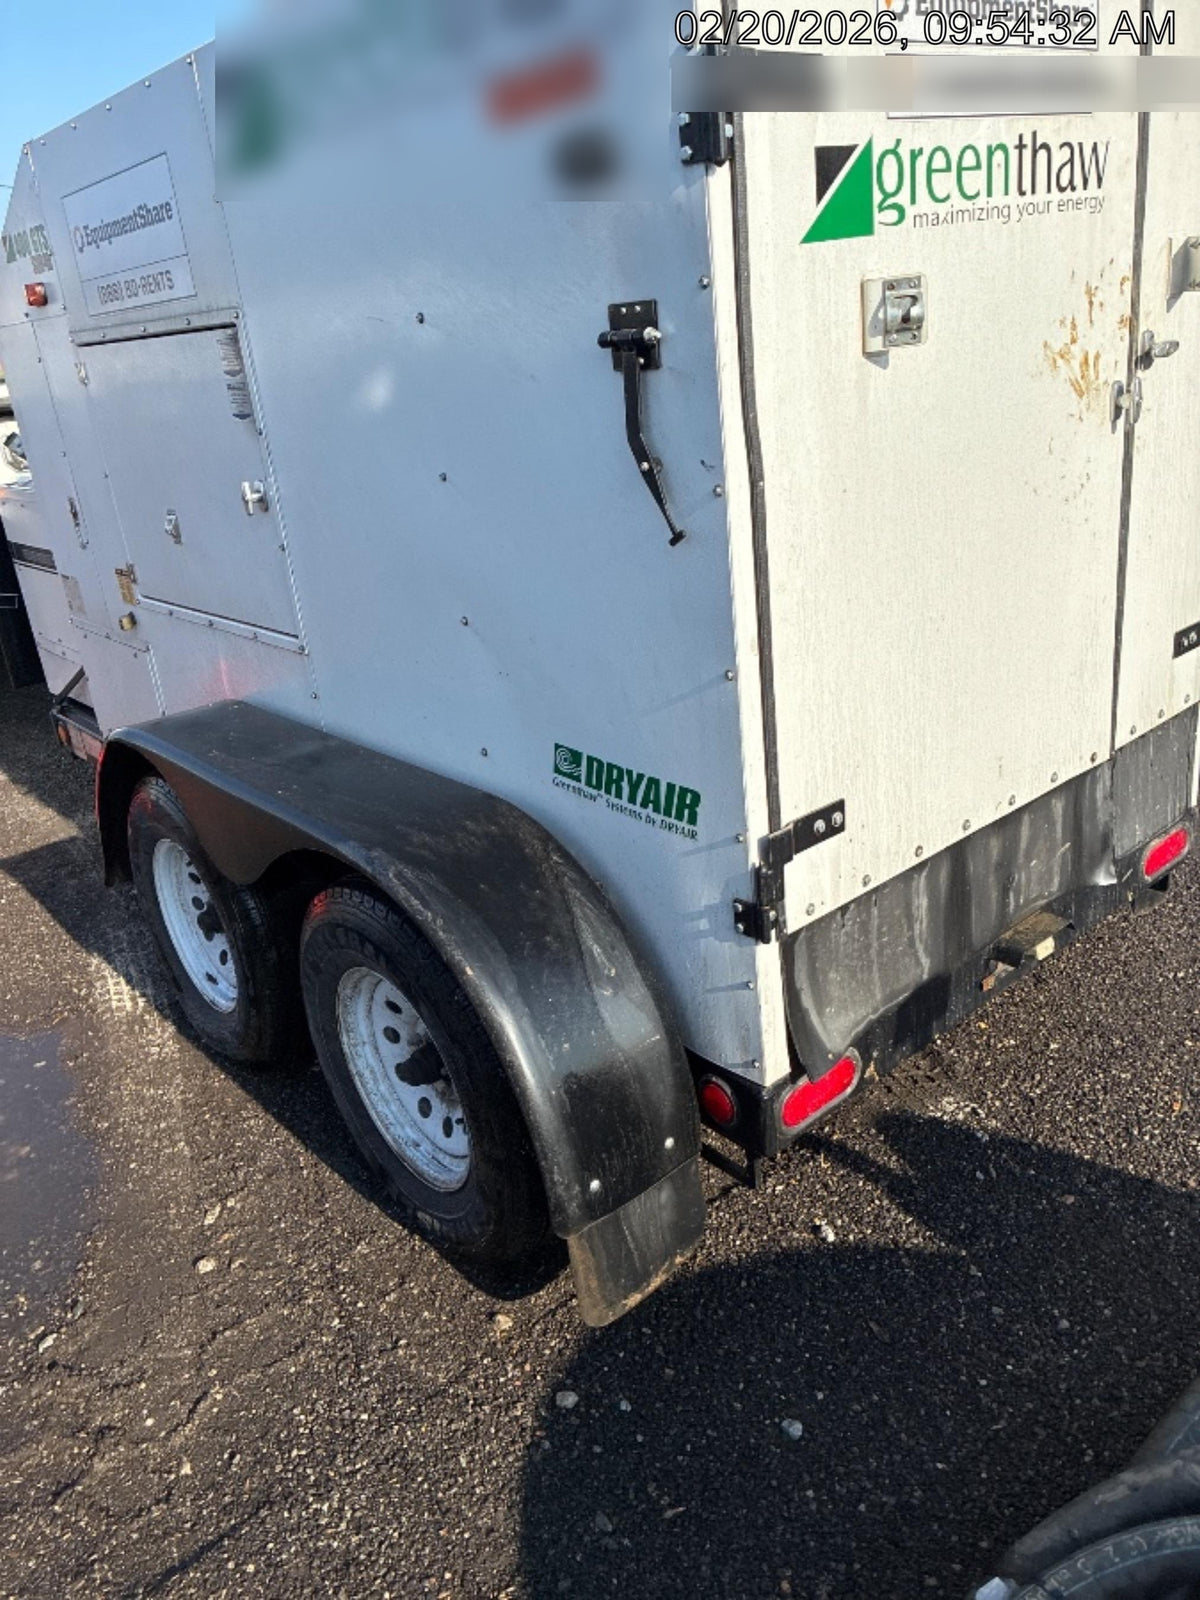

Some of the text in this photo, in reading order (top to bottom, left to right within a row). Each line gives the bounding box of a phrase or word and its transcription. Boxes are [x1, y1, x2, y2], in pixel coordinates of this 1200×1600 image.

[876, 129, 1110, 226] greenthaw
[82, 201, 174, 250] EquipmentShare
[913, 195, 1105, 228] maximizing your energy
[585, 754, 701, 826] DRYAIR
